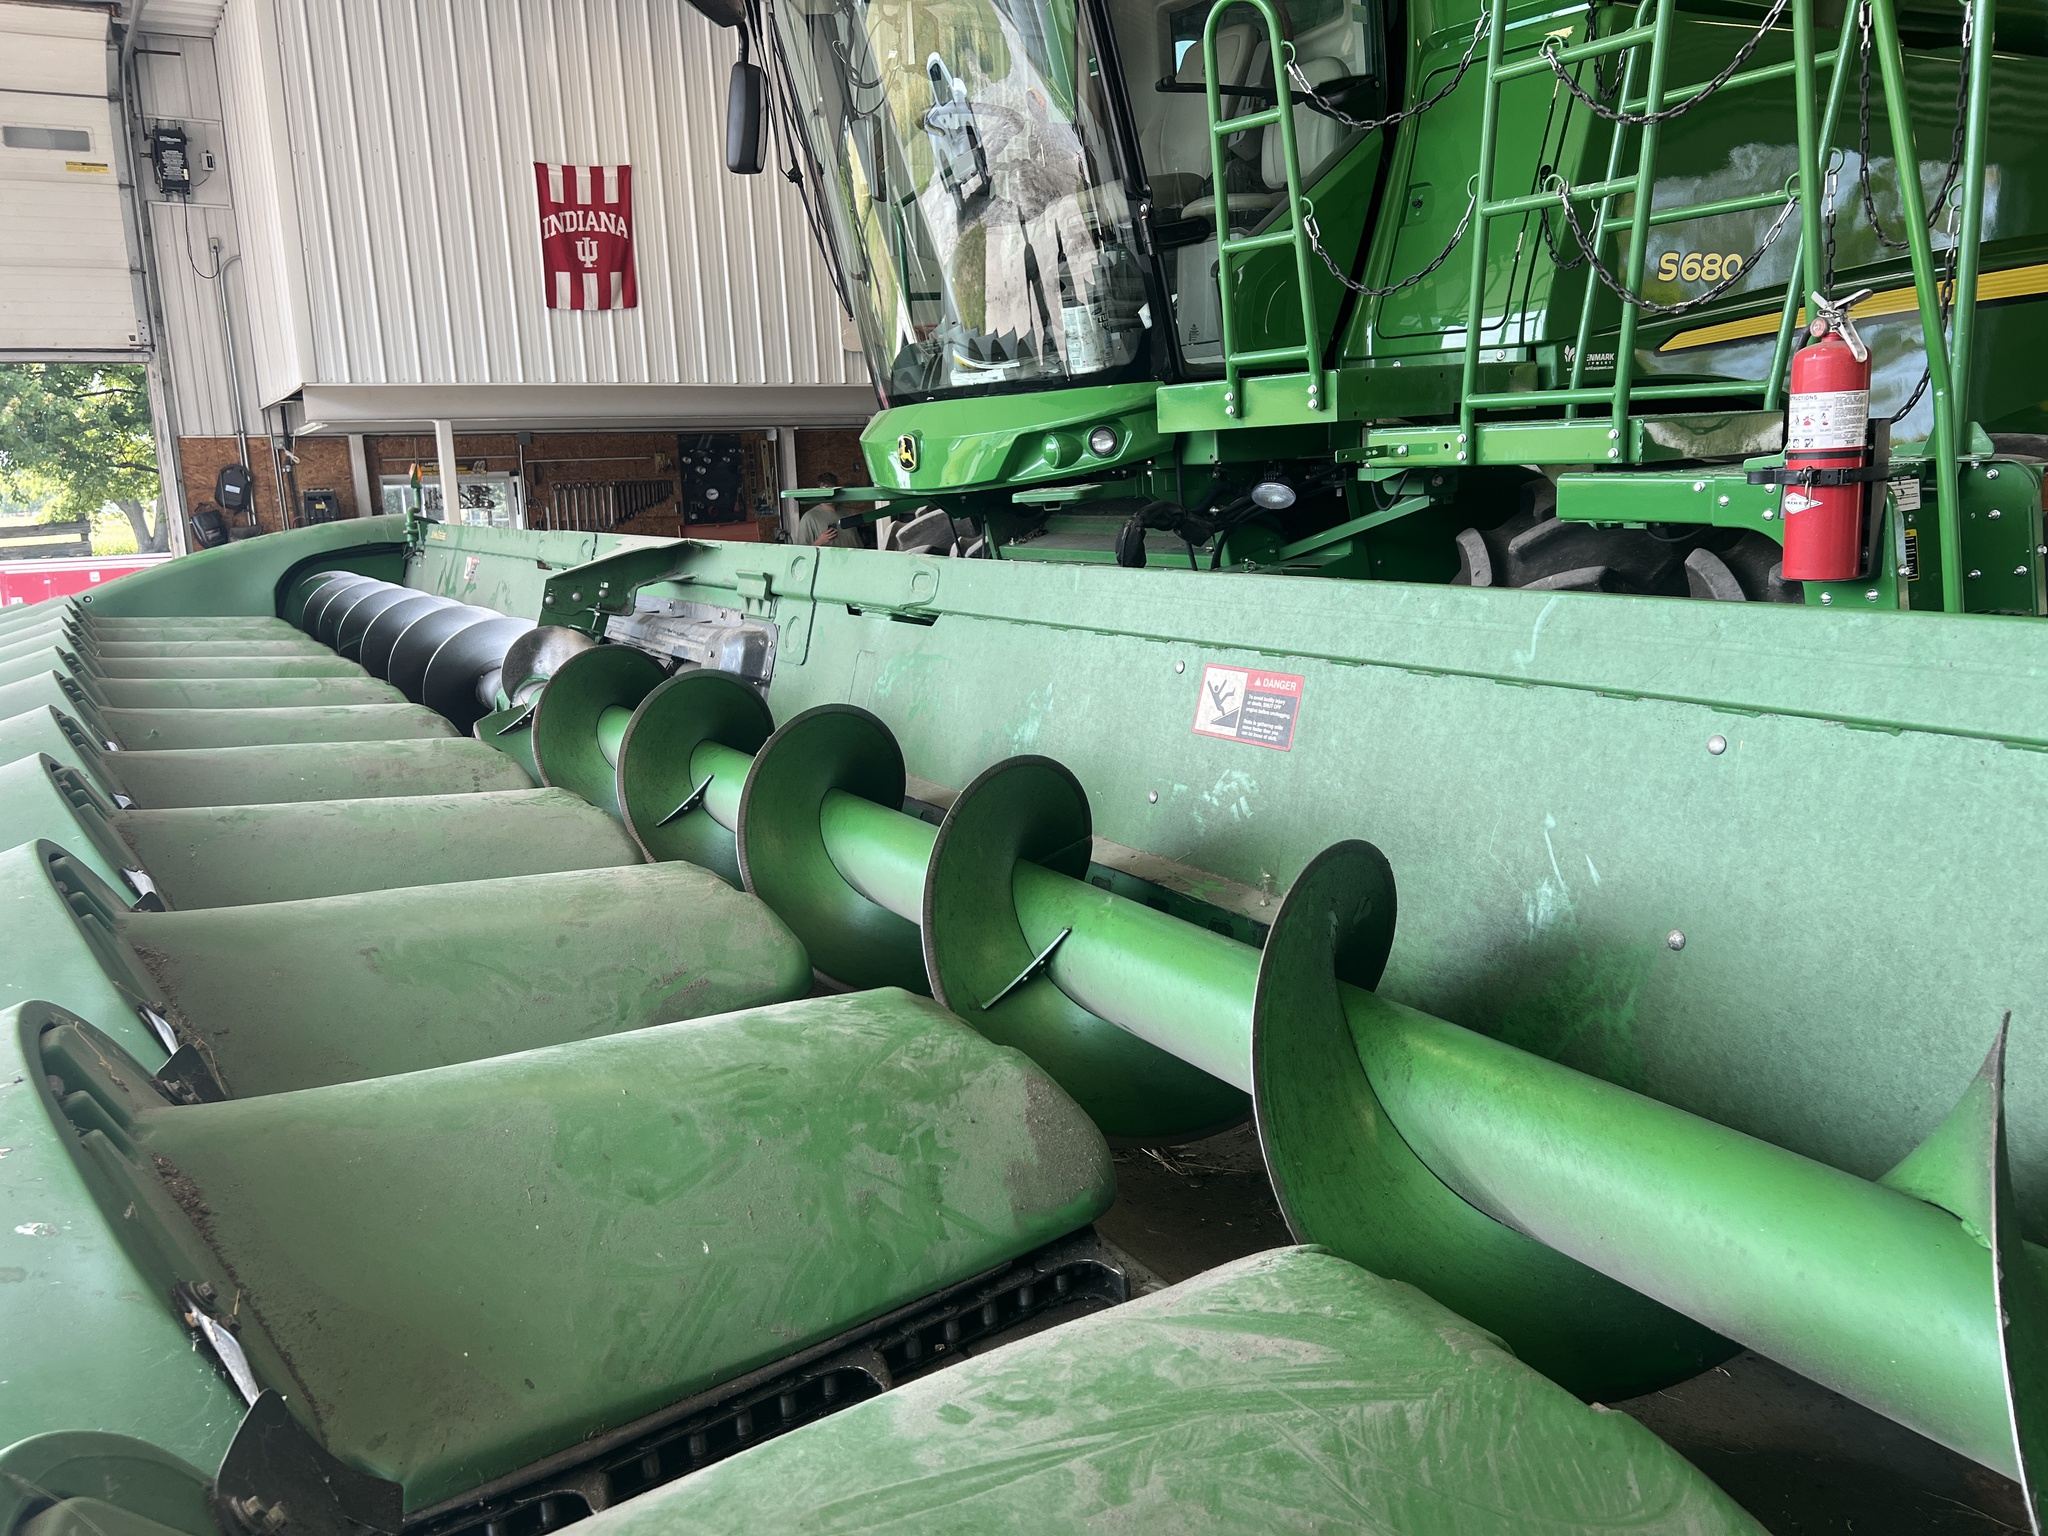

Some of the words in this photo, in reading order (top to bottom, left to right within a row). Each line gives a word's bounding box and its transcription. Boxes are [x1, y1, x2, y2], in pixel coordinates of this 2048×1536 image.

[542, 210, 629, 240] INDIANA
[1657, 252, 1743, 282] S680
[1263, 678, 1296, 691] DANGER
